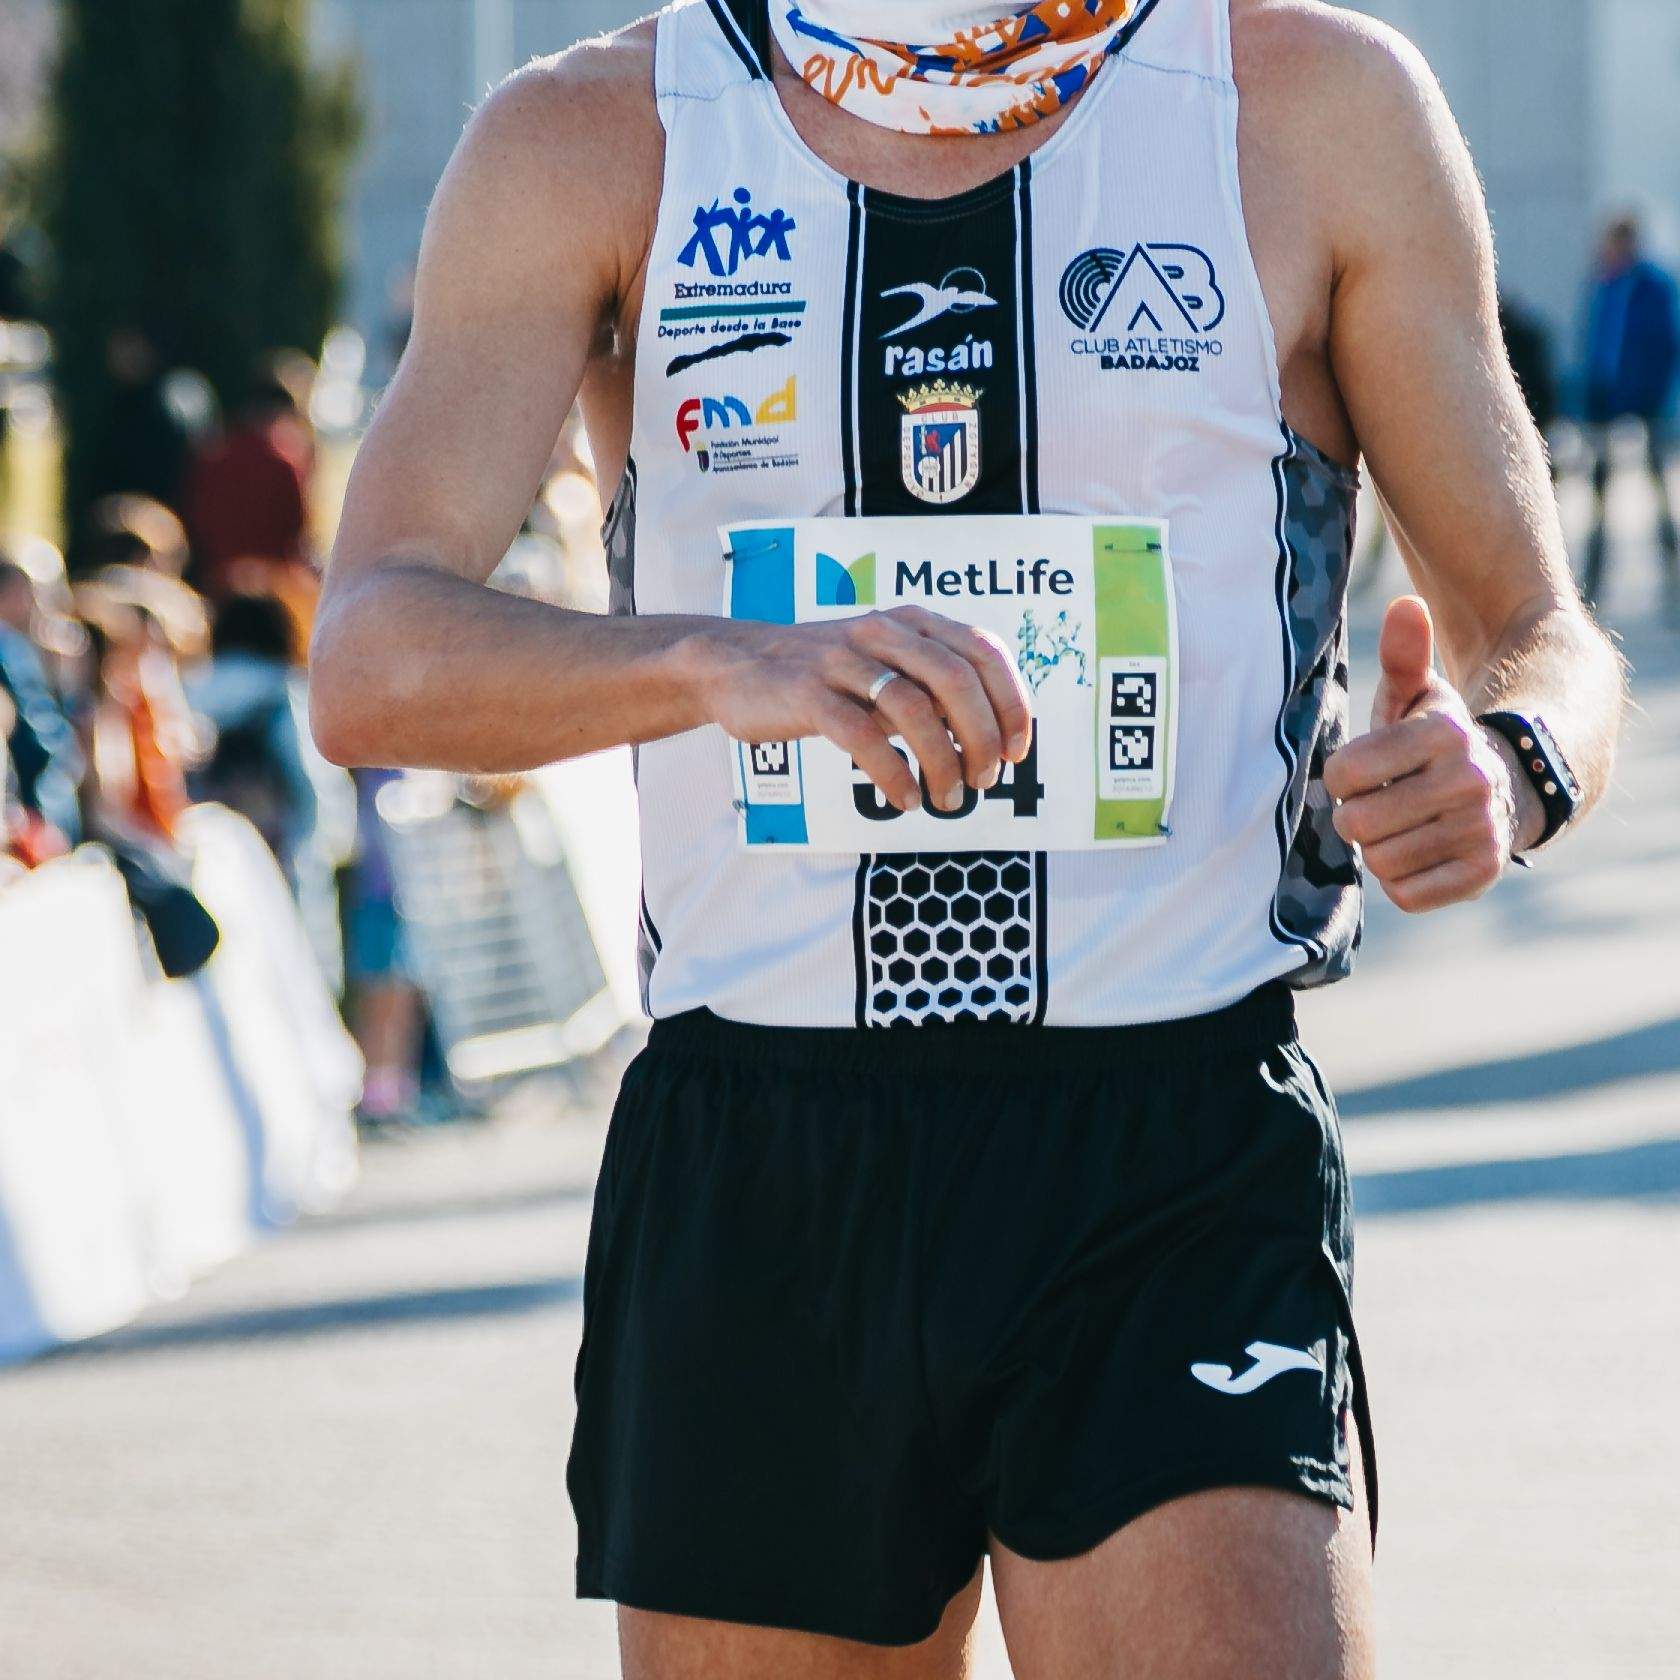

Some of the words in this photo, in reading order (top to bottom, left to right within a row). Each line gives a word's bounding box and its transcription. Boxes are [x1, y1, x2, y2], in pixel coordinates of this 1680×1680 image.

[673, 280, 792, 299] Extremadura
[657, 324, 706, 340] Deporte
[710, 318, 749, 334] desde
[753, 317, 766, 330] la
[883, 332, 994, 377] rasán
[1070, 337, 1120, 355] CLUB
[1124, 337, 1223, 356] ATLETISMO
[1100, 354, 1200, 372] BADAJOZ
[894, 558, 1075, 597] MetLife
